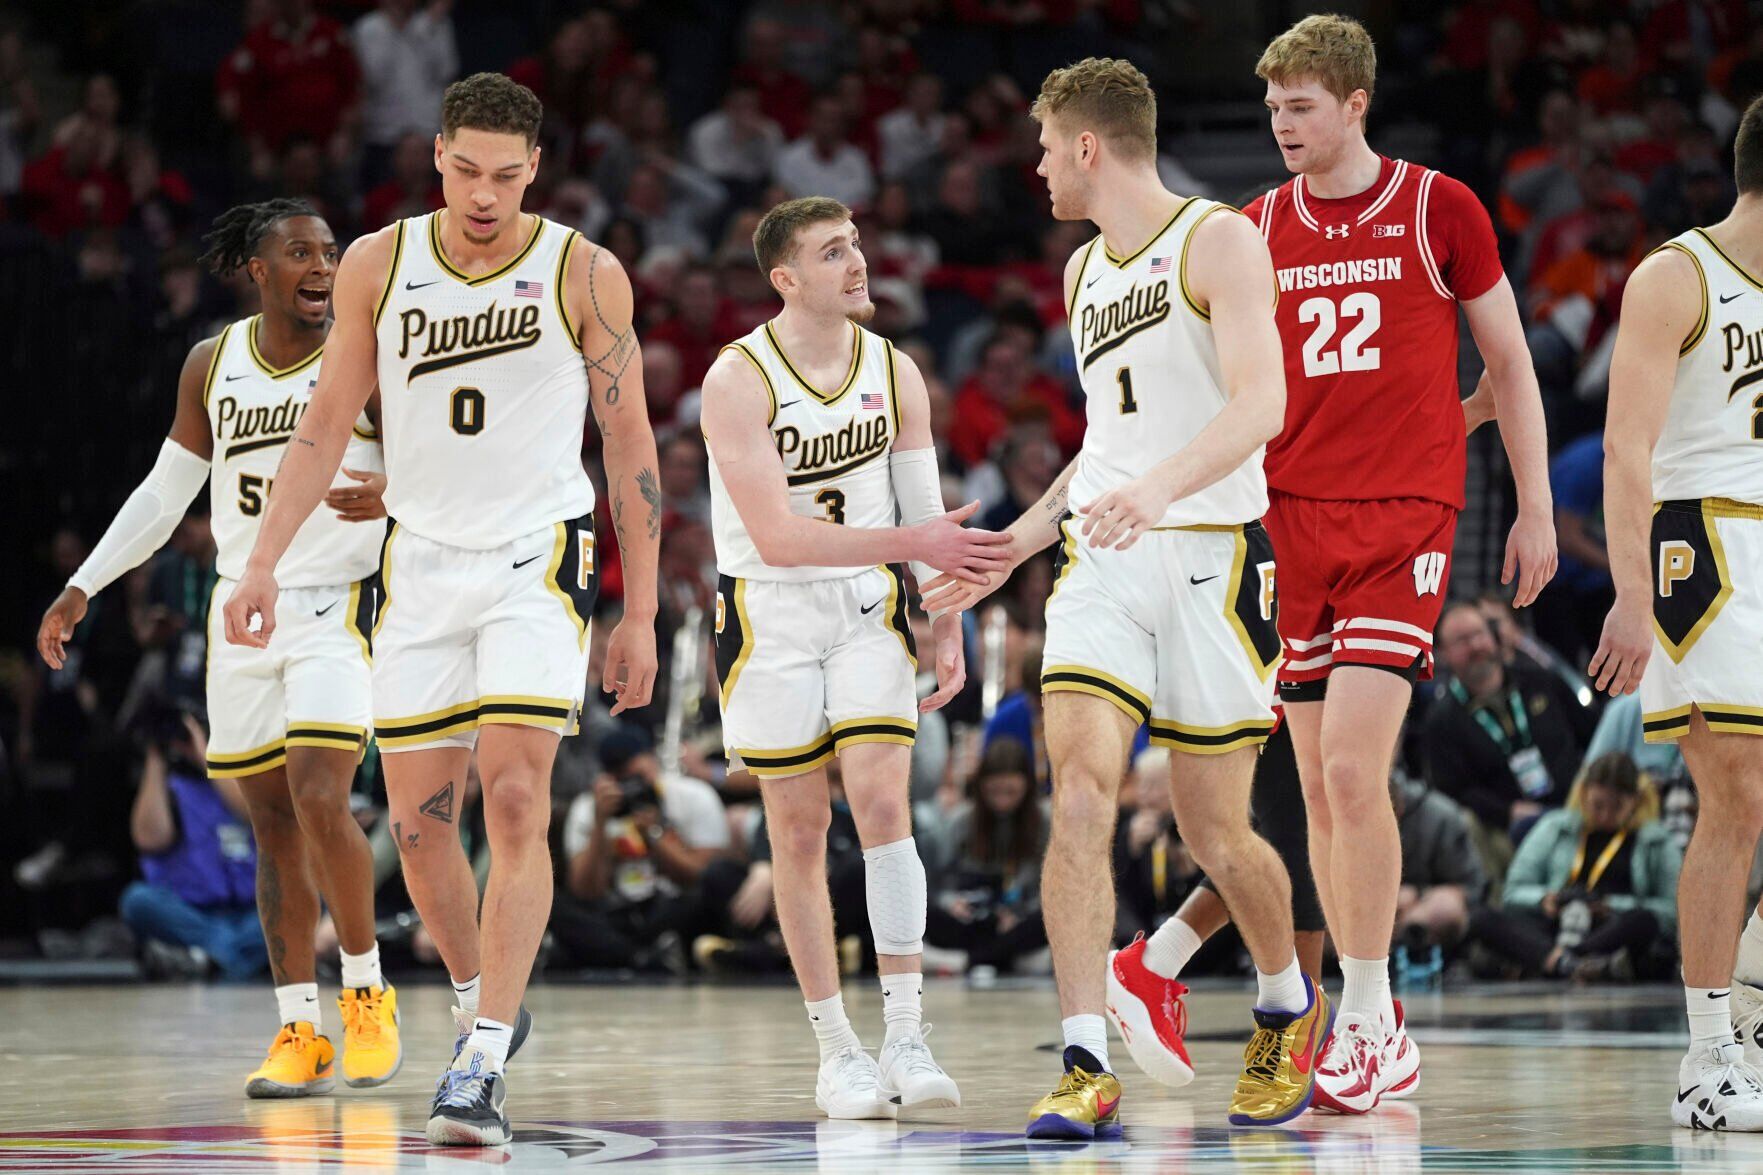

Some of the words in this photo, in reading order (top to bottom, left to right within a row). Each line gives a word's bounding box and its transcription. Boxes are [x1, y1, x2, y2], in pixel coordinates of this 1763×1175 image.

[1276, 256, 1402, 293] WISCONSIN
[398, 299, 541, 360] Purdue
[1080, 279, 1171, 354] Purdue
[1298, 291, 1381, 378] 22
[1720, 321, 1763, 373] Pu
[449, 386, 485, 436] 0
[1115, 366, 1138, 416] 1
[216, 393, 307, 440] Purdu
[774, 414, 889, 472] Purdue
[237, 472, 274, 518] 5
[813, 487, 846, 525] 3
[1412, 551, 1447, 598] W
[1659, 540, 1696, 598] P
